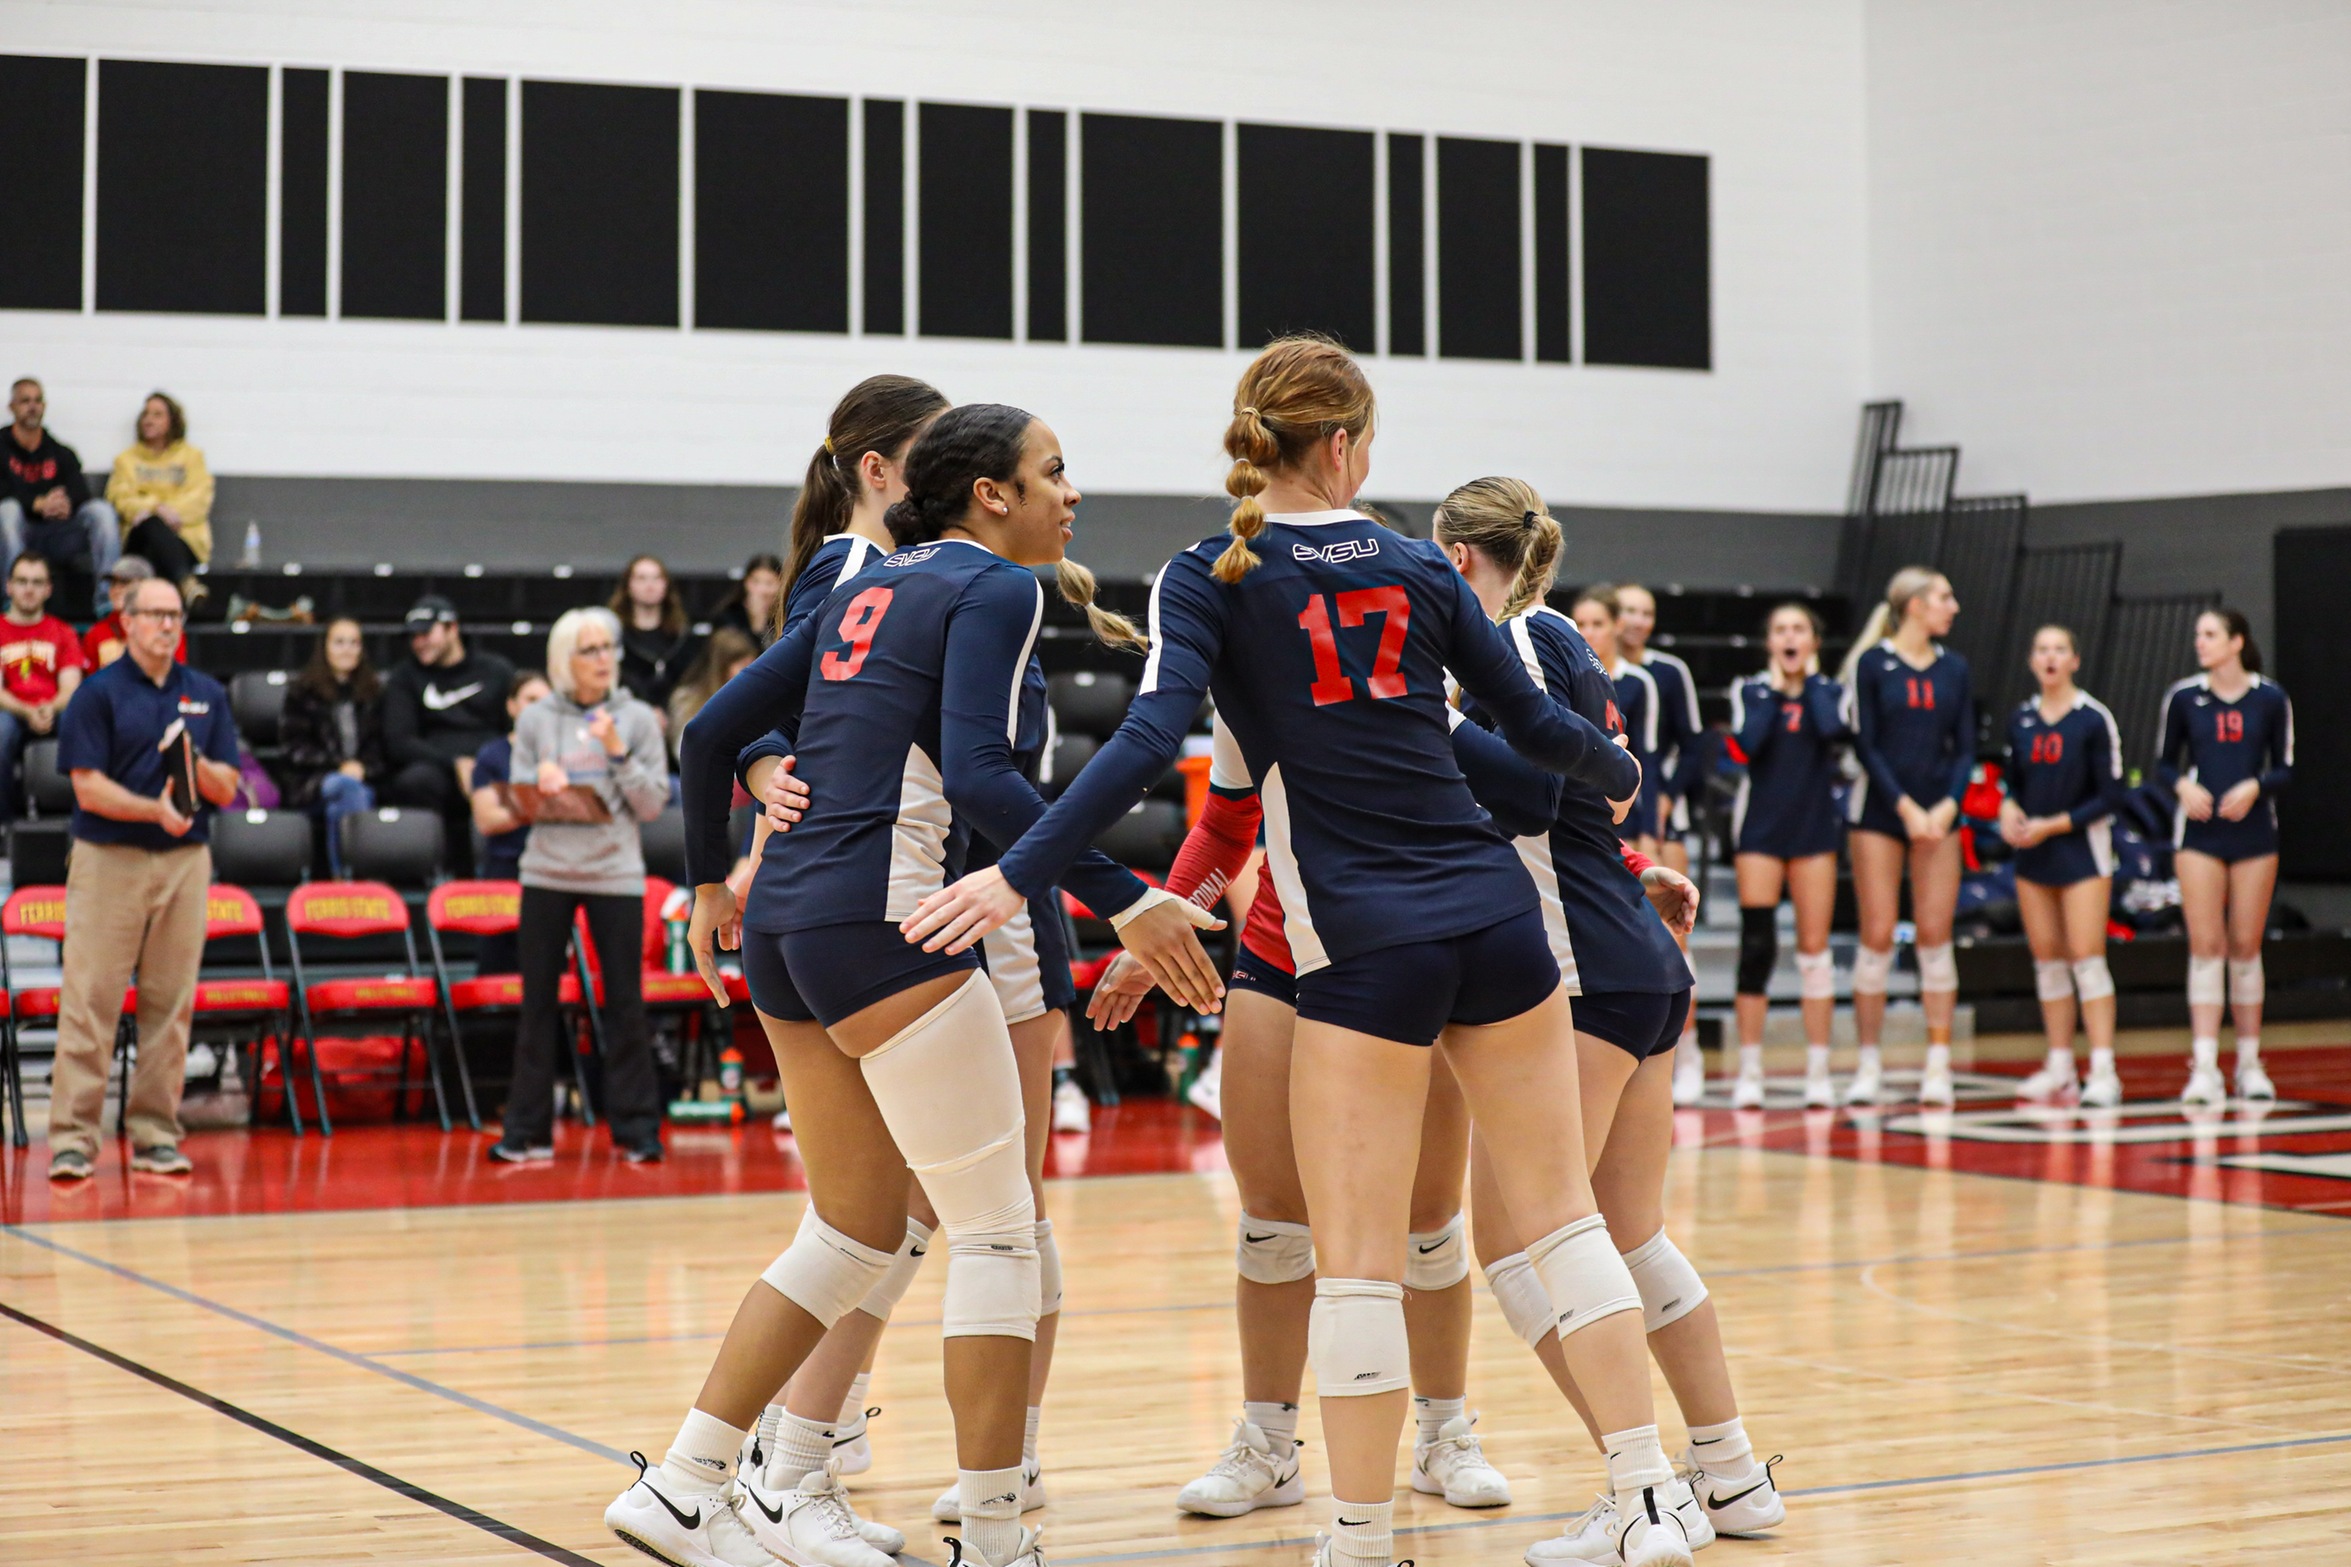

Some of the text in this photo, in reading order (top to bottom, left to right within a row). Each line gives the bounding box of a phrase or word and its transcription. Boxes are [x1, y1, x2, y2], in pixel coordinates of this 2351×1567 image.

[1293, 538, 1379, 563] SVSU
[820, 586, 893, 681] 9
[1297, 584, 1411, 706] 17
[1906, 678, 1935, 710] 11
[1782, 703, 1803, 732] 7
[2215, 710, 2243, 742] 19
[2030, 732, 2063, 763] 10
